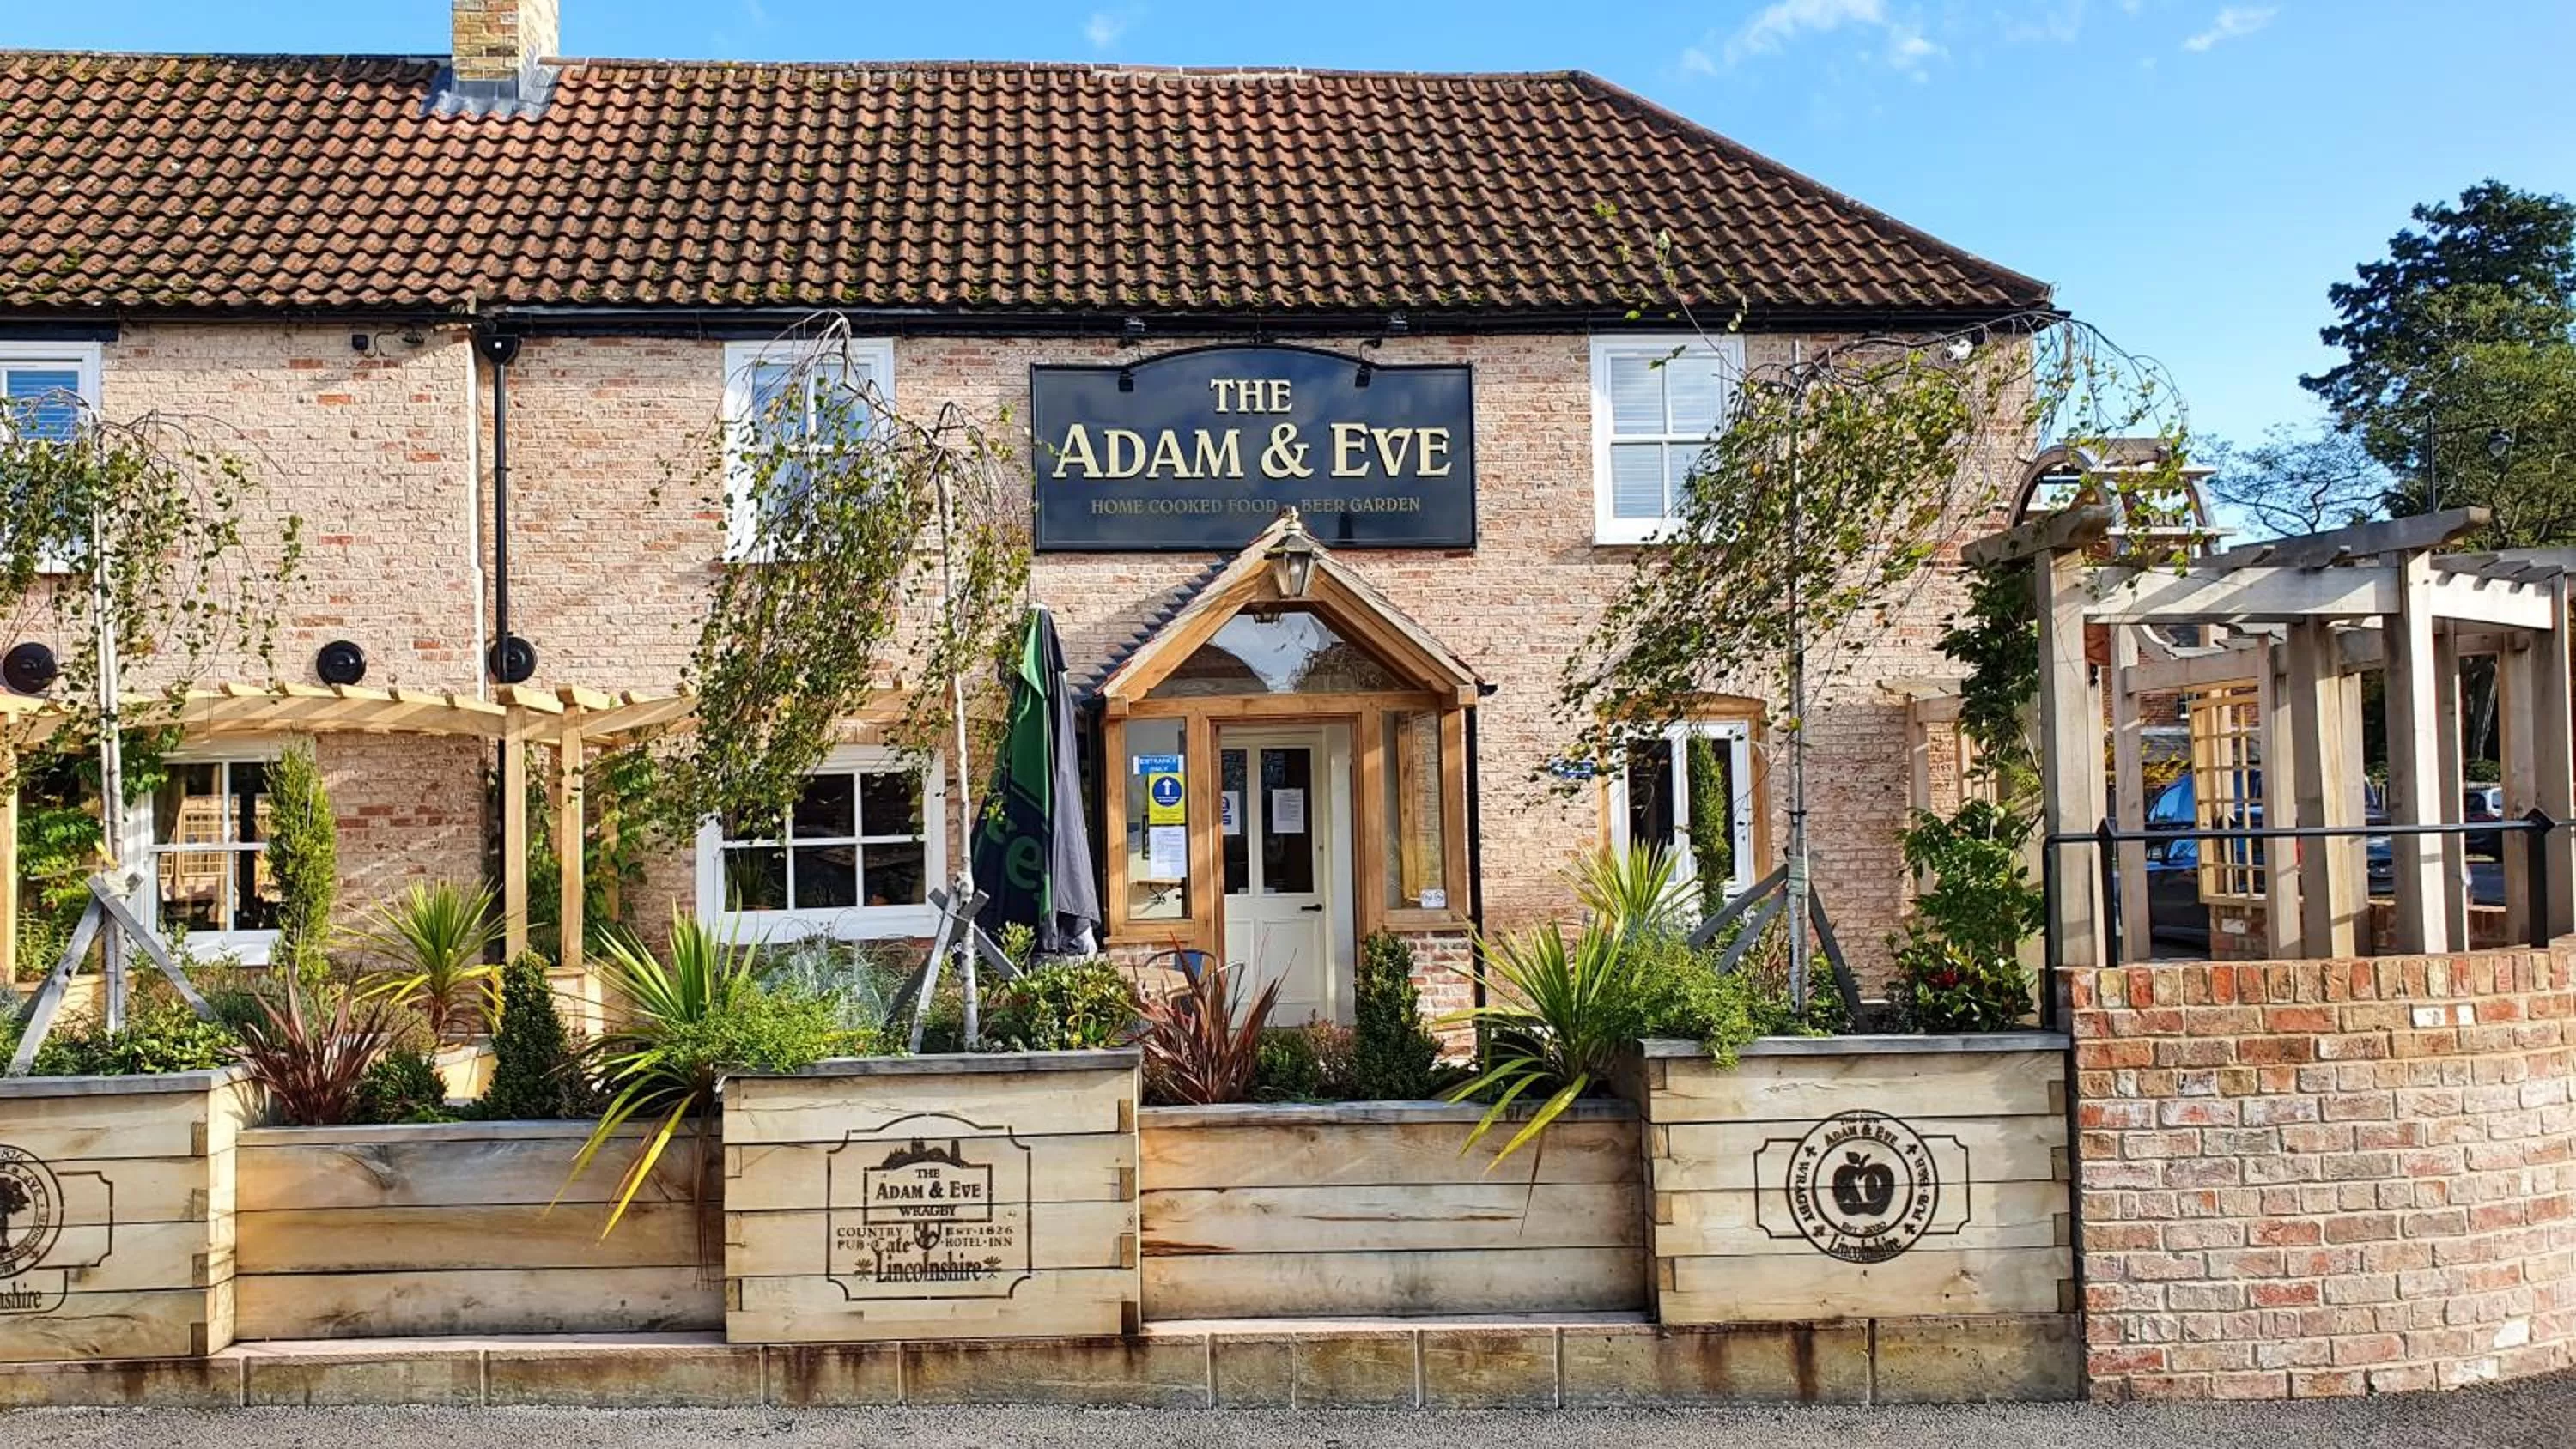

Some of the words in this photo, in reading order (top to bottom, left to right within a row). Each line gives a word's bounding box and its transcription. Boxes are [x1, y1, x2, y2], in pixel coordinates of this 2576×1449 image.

[1211, 379, 1292, 413] THE
[1052, 424, 1244, 479] ADAM
[1261, 422, 1315, 479] &
[1330, 422, 1453, 478] EVE
[1091, 499, 1143, 514] HOME
[1148, 499, 1222, 513] COOKED
[1228, 498, 1277, 513] FOOD
[1301, 498, 1345, 512] BEER
[1349, 497, 1421, 512] GARDEN
[1824, 1125, 1857, 1147] ADAM
[1861, 1124, 1872, 1136] &
[915, 1168, 940, 1179] THE
[876, 1182, 924, 1199] ADAM
[928, 1180, 944, 1199] &
[949, 1180, 981, 1198] EVE
[1795, 1162, 1815, 1222] WRAGBY
[898, 1204, 956, 1216] WRAGBY
[837, 1227, 902, 1238] COUNTRY
[837, 1239, 864, 1250] PUB
[875, 1251, 981, 1282] Lincolnshire
